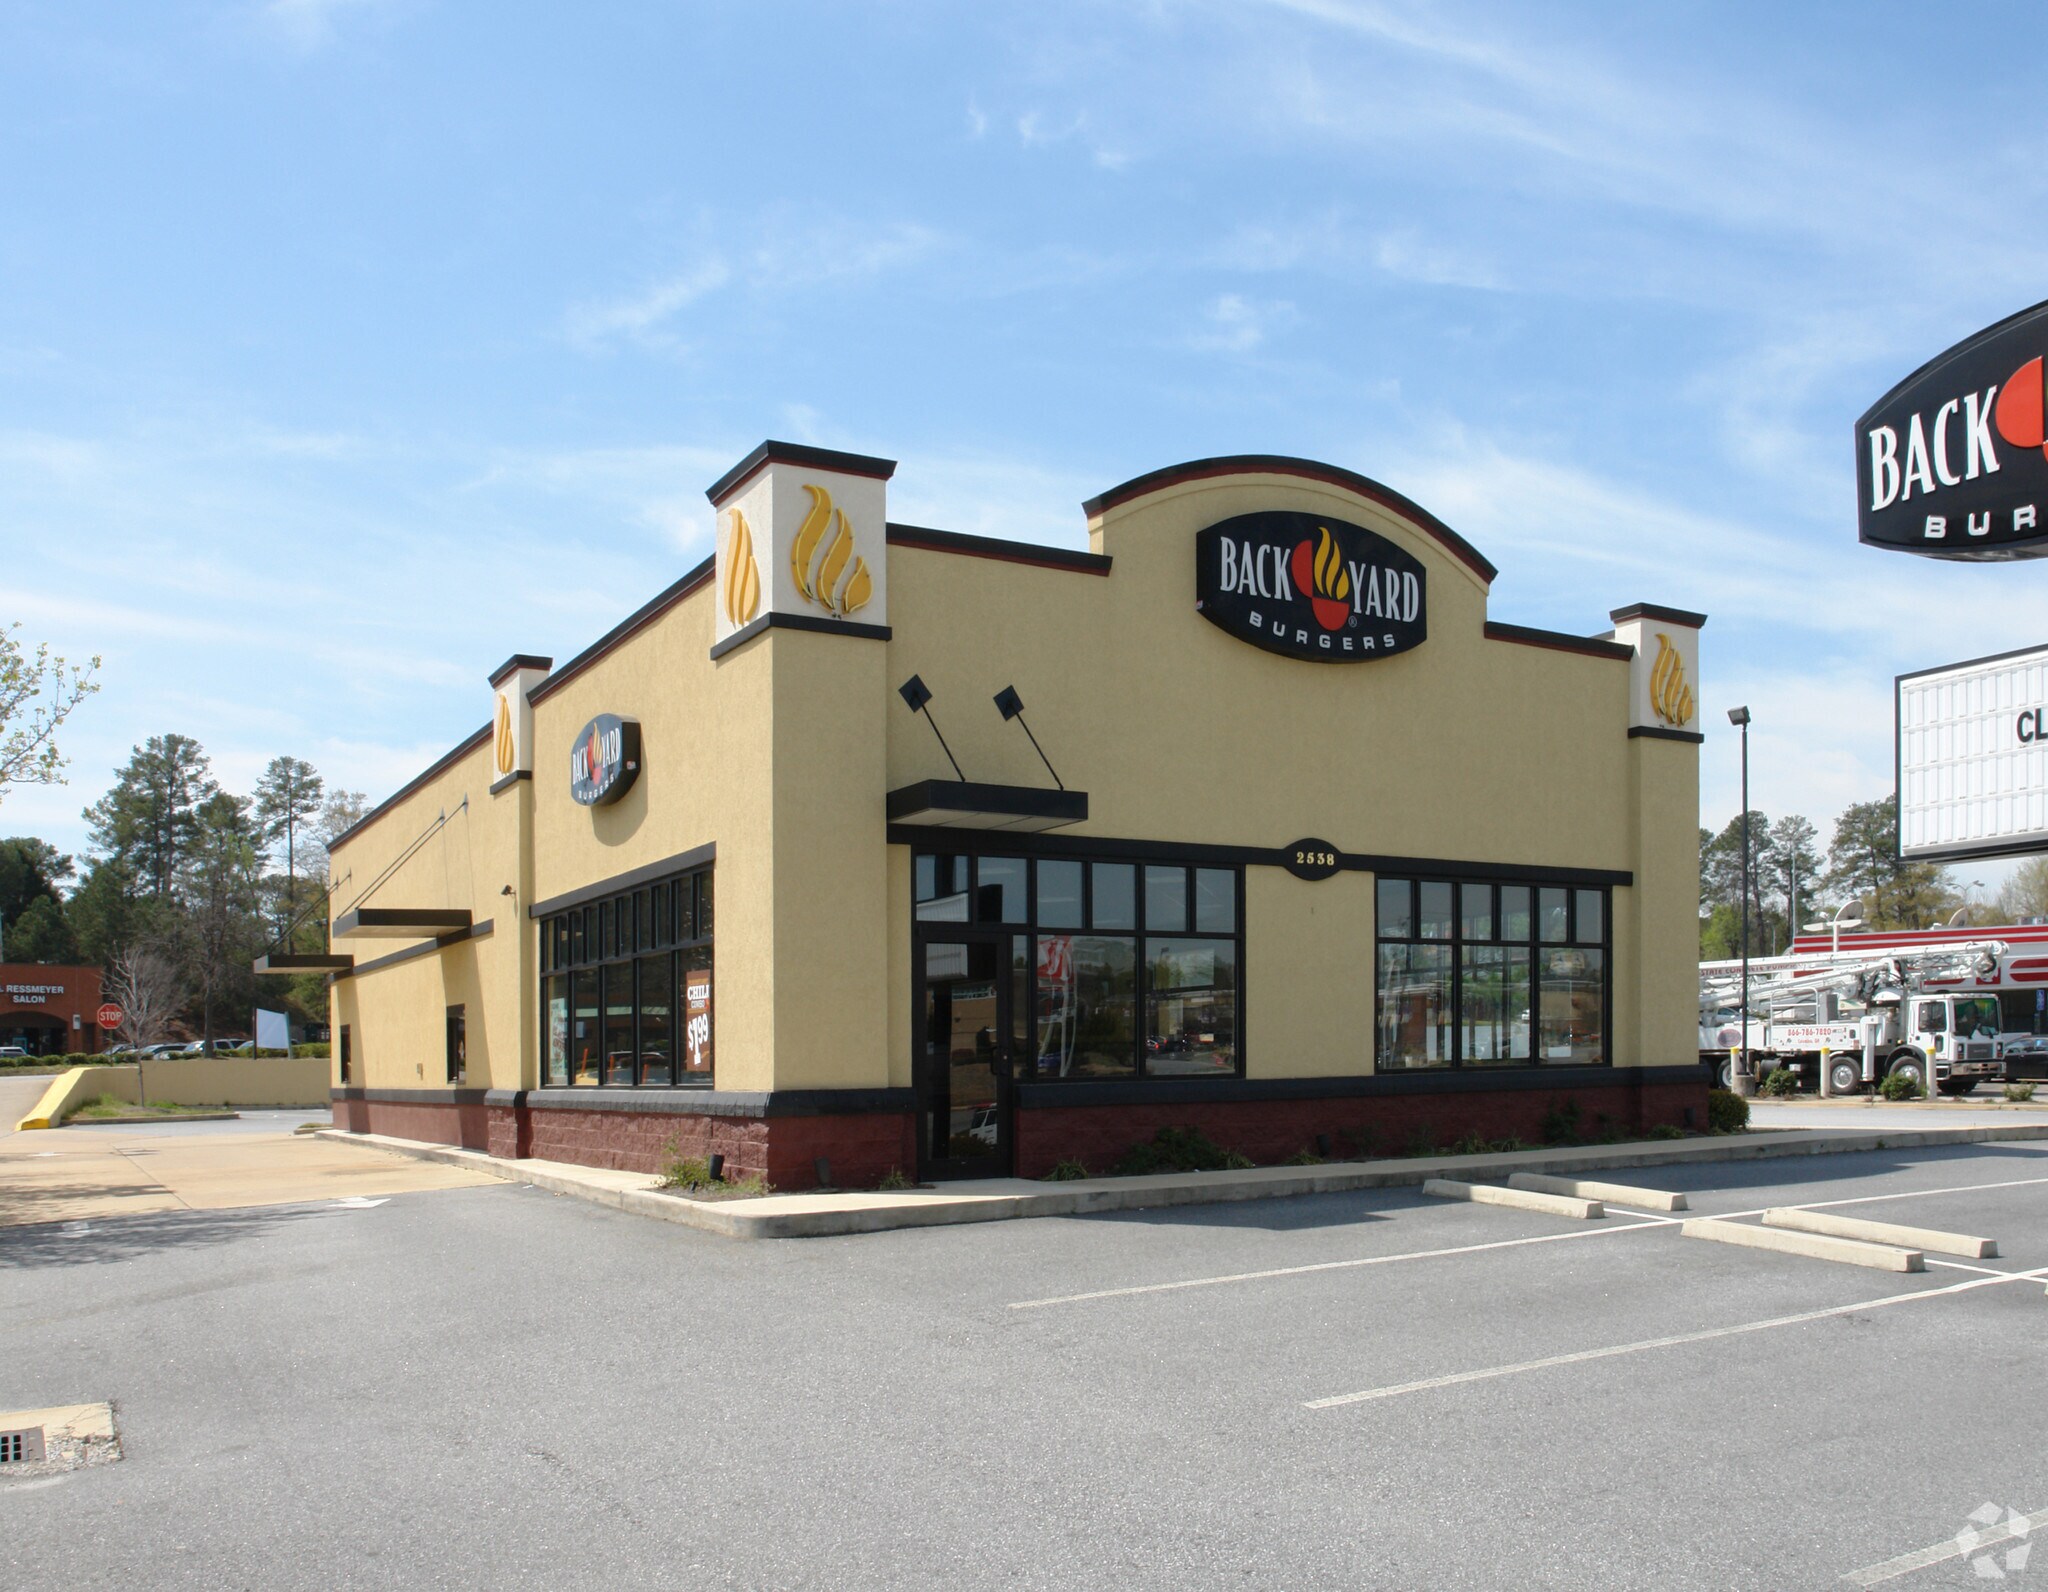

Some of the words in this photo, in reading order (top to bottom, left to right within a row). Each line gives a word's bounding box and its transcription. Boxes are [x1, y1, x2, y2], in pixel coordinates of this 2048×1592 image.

[1869, 385, 2000, 512] BACK
[1924, 504, 2037, 539] BUR
[1220, 536, 1293, 601] BACK
[1349, 561, 1419, 623] YARD
[1249, 610, 1396, 651] BURGERS
[2016, 707, 2048, 743] CL
[572, 746, 589, 785] BACK
[601, 728, 621, 769] YARD
[1296, 851, 1335, 866] 2538
[6, 985, 64, 994] RESSMEYER
[13, 995, 46, 1003] SALON
[687, 984, 710, 1001] CHILI
[100, 1011, 122, 1021] STOP
